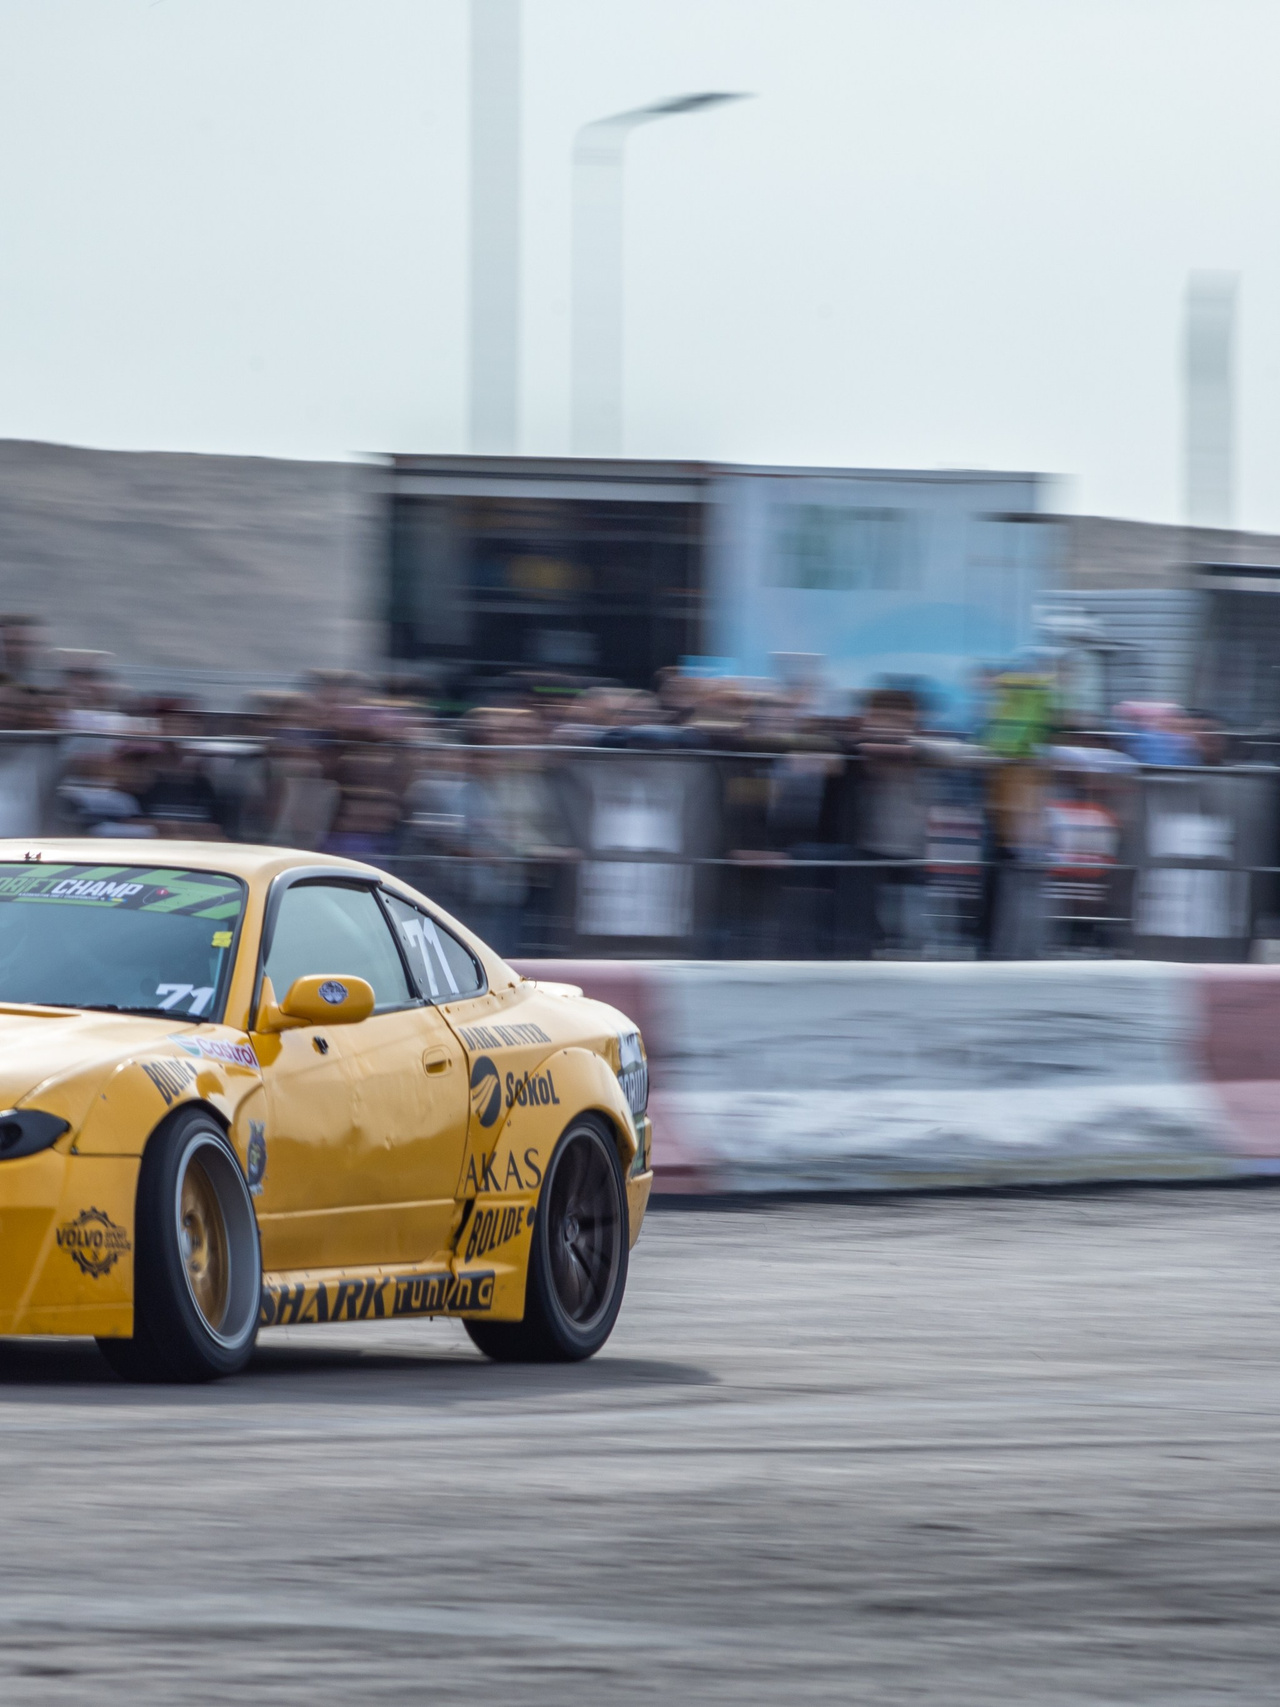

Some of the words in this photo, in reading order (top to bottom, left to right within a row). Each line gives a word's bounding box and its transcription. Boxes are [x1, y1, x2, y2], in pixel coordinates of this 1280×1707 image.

[401, 917, 460, 997] 71
[155, 983, 215, 1017] 71
[195, 1037, 259, 1068] Castrol
[458, 1026, 502, 1051] DARK
[491, 1022, 552, 1047] HUNTER
[463, 1147, 542, 1194] AKAS
[56, 1227, 103, 1248] VOLVO
[464, 1206, 525, 1265] BOLIDE
[261, 1275, 391, 1327] SHARK
